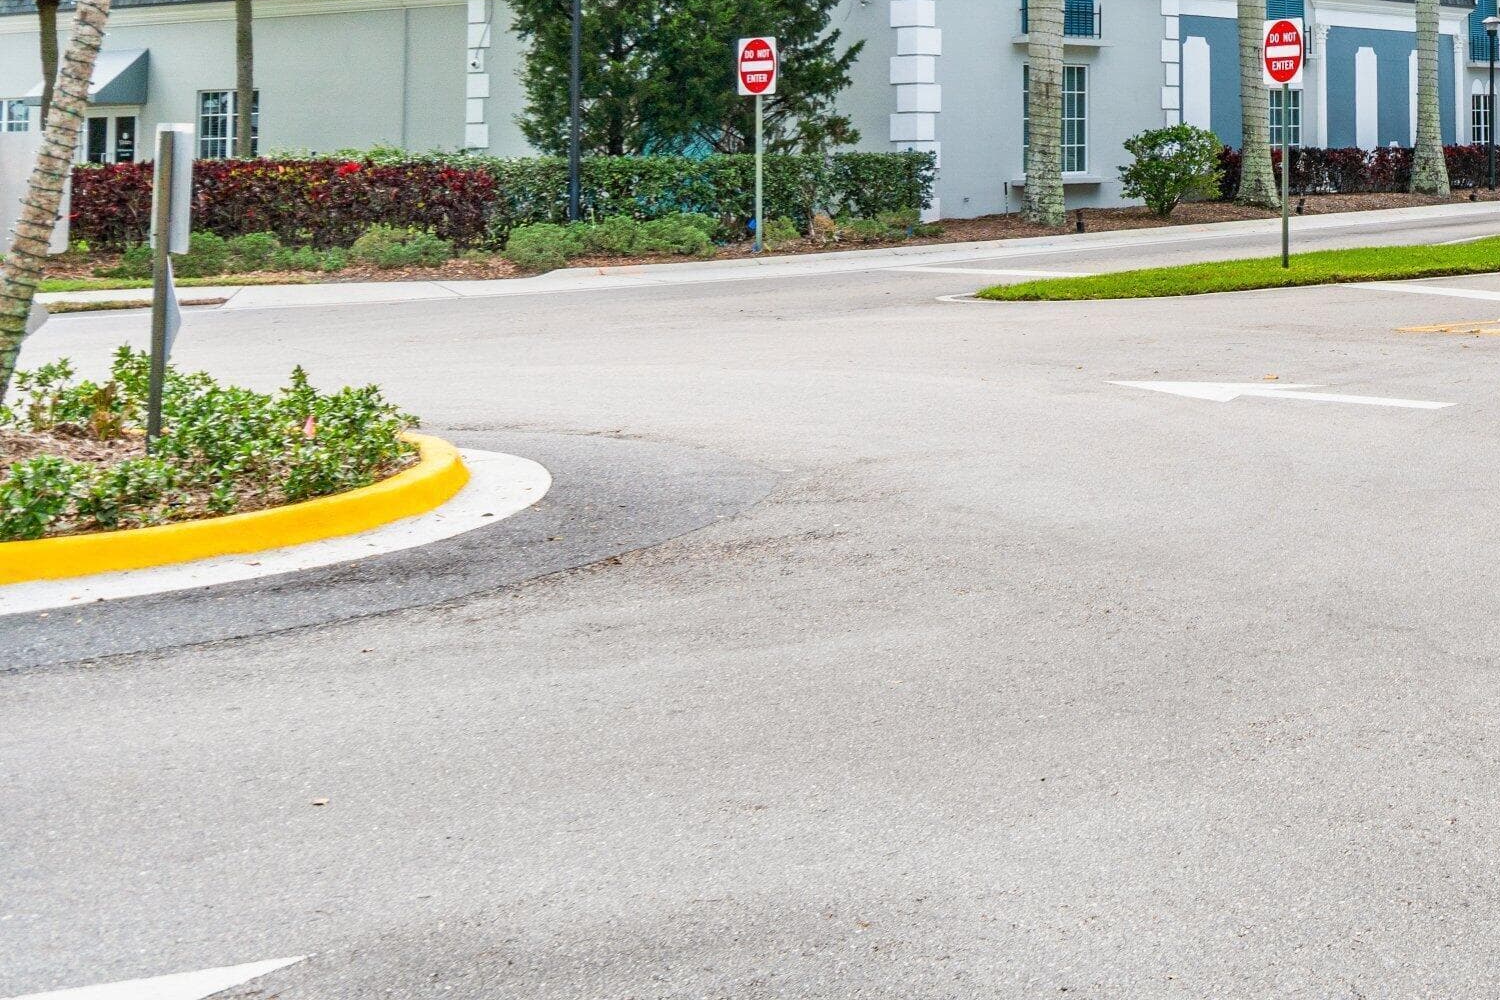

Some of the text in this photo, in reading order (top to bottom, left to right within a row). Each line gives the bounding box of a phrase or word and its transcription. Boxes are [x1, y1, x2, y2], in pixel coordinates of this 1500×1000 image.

[1269, 31, 1297, 44] DO NOT
[744, 48, 770, 59] DO NOT
[1271, 60, 1294, 71] ENTER
[746, 73, 768, 84] ENTER
